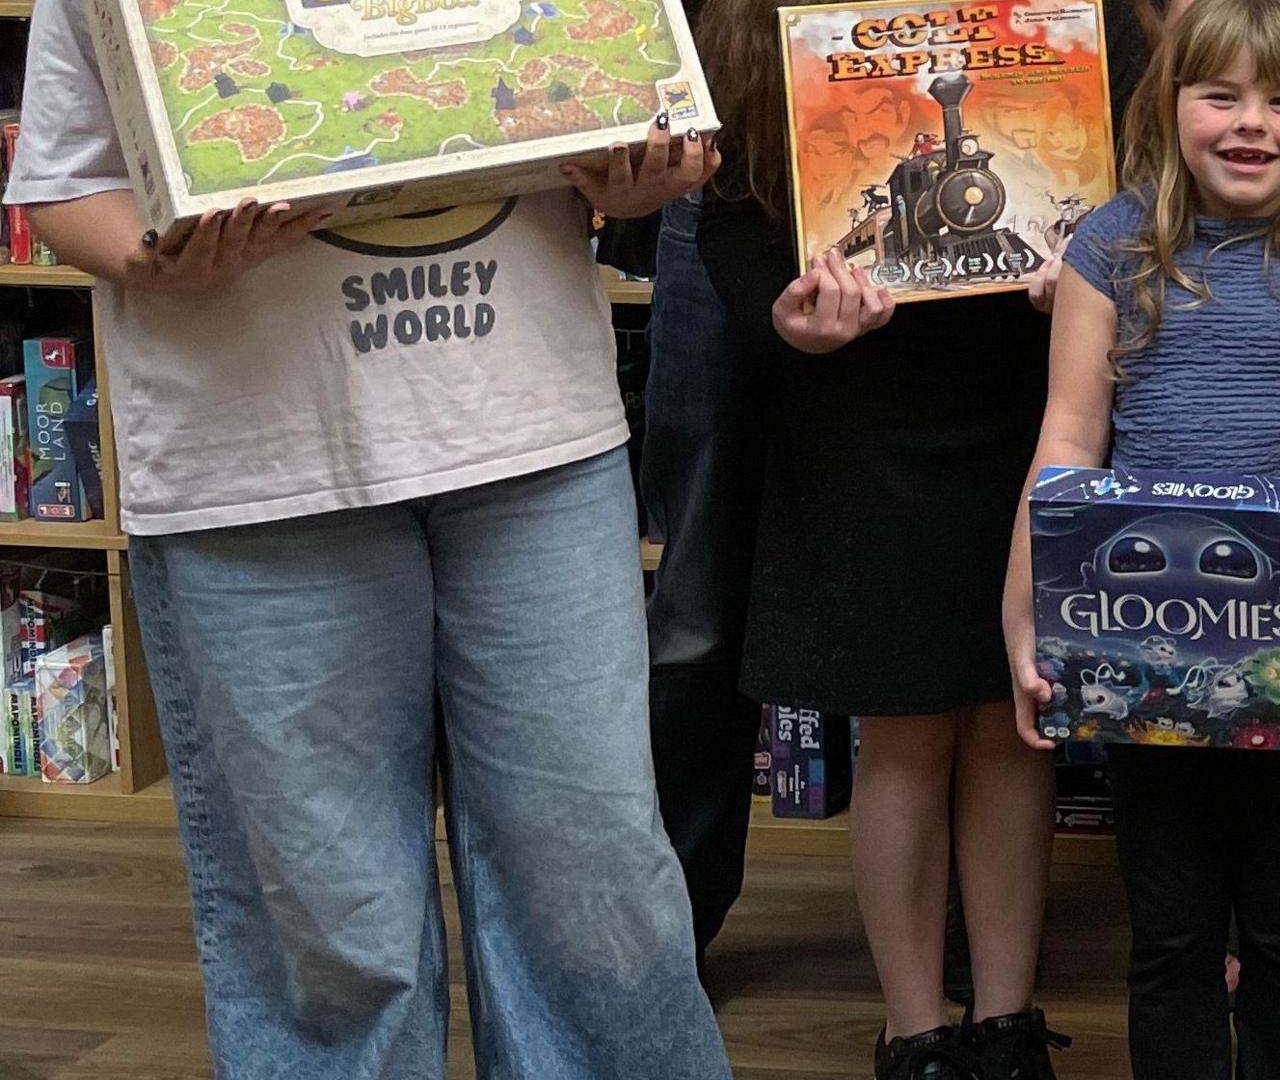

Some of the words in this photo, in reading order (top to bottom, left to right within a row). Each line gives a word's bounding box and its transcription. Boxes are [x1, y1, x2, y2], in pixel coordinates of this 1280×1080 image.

[850, 4, 1000, 51] COLT
[827, 43, 1067, 83] EXPRESS
[341, 258, 499, 314] SMILEY
[349, 302, 498, 354] WORLD
[36, 400, 51, 462] MOOR
[52, 398, 67, 462] LAND
[1151, 480, 1256, 501] GLOOMIES
